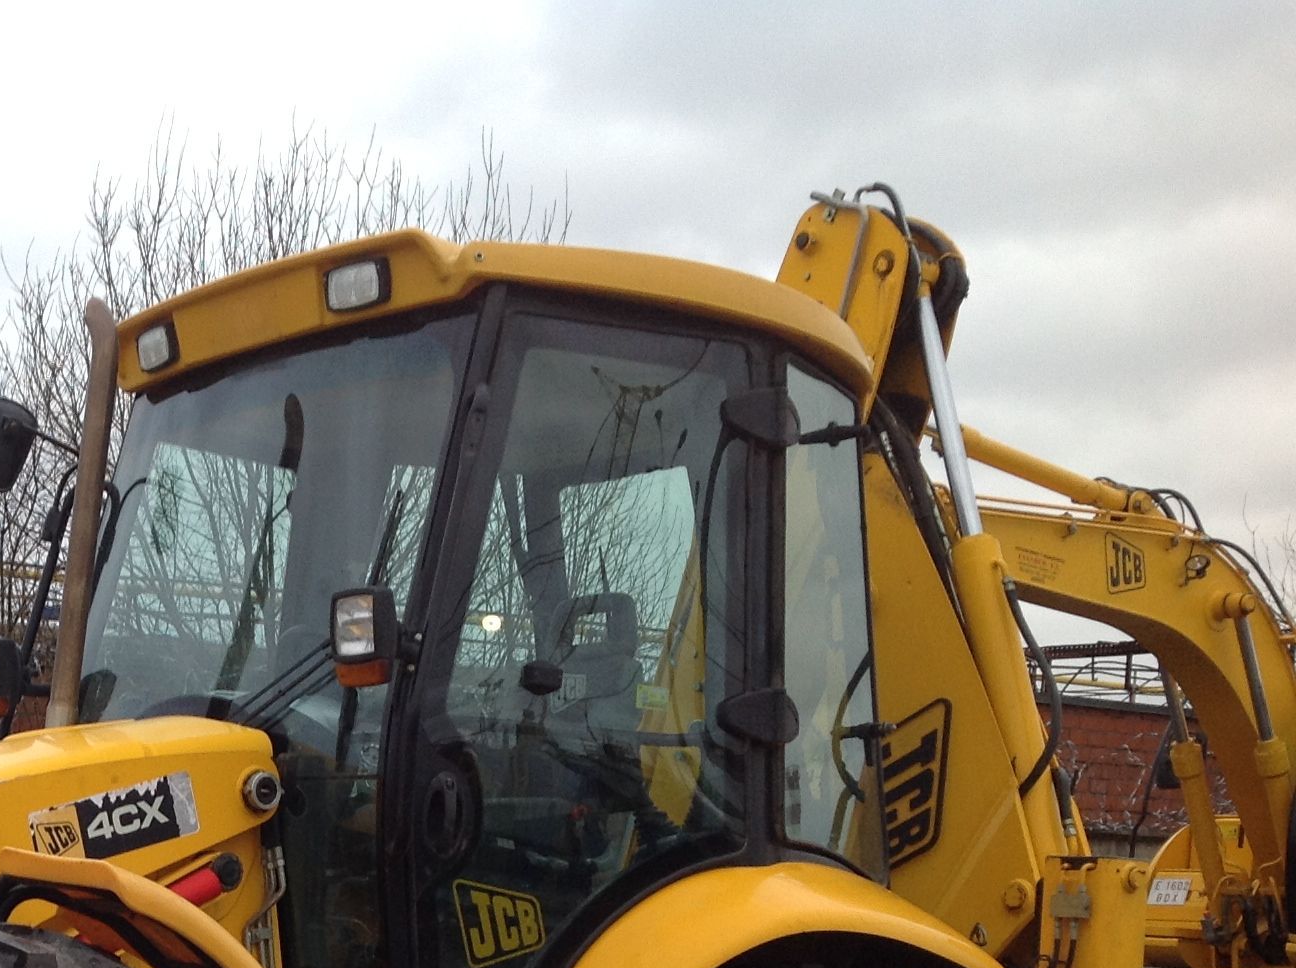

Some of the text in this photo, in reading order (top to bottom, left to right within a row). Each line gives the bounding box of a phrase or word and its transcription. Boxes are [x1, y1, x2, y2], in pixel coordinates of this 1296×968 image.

[1110, 541, 1142, 587] JCB
[881, 729, 938, 859] JCB
[44, 825, 76, 855] JCB
[87, 796, 169, 840] 4CX
[470, 890, 539, 959] JCB
